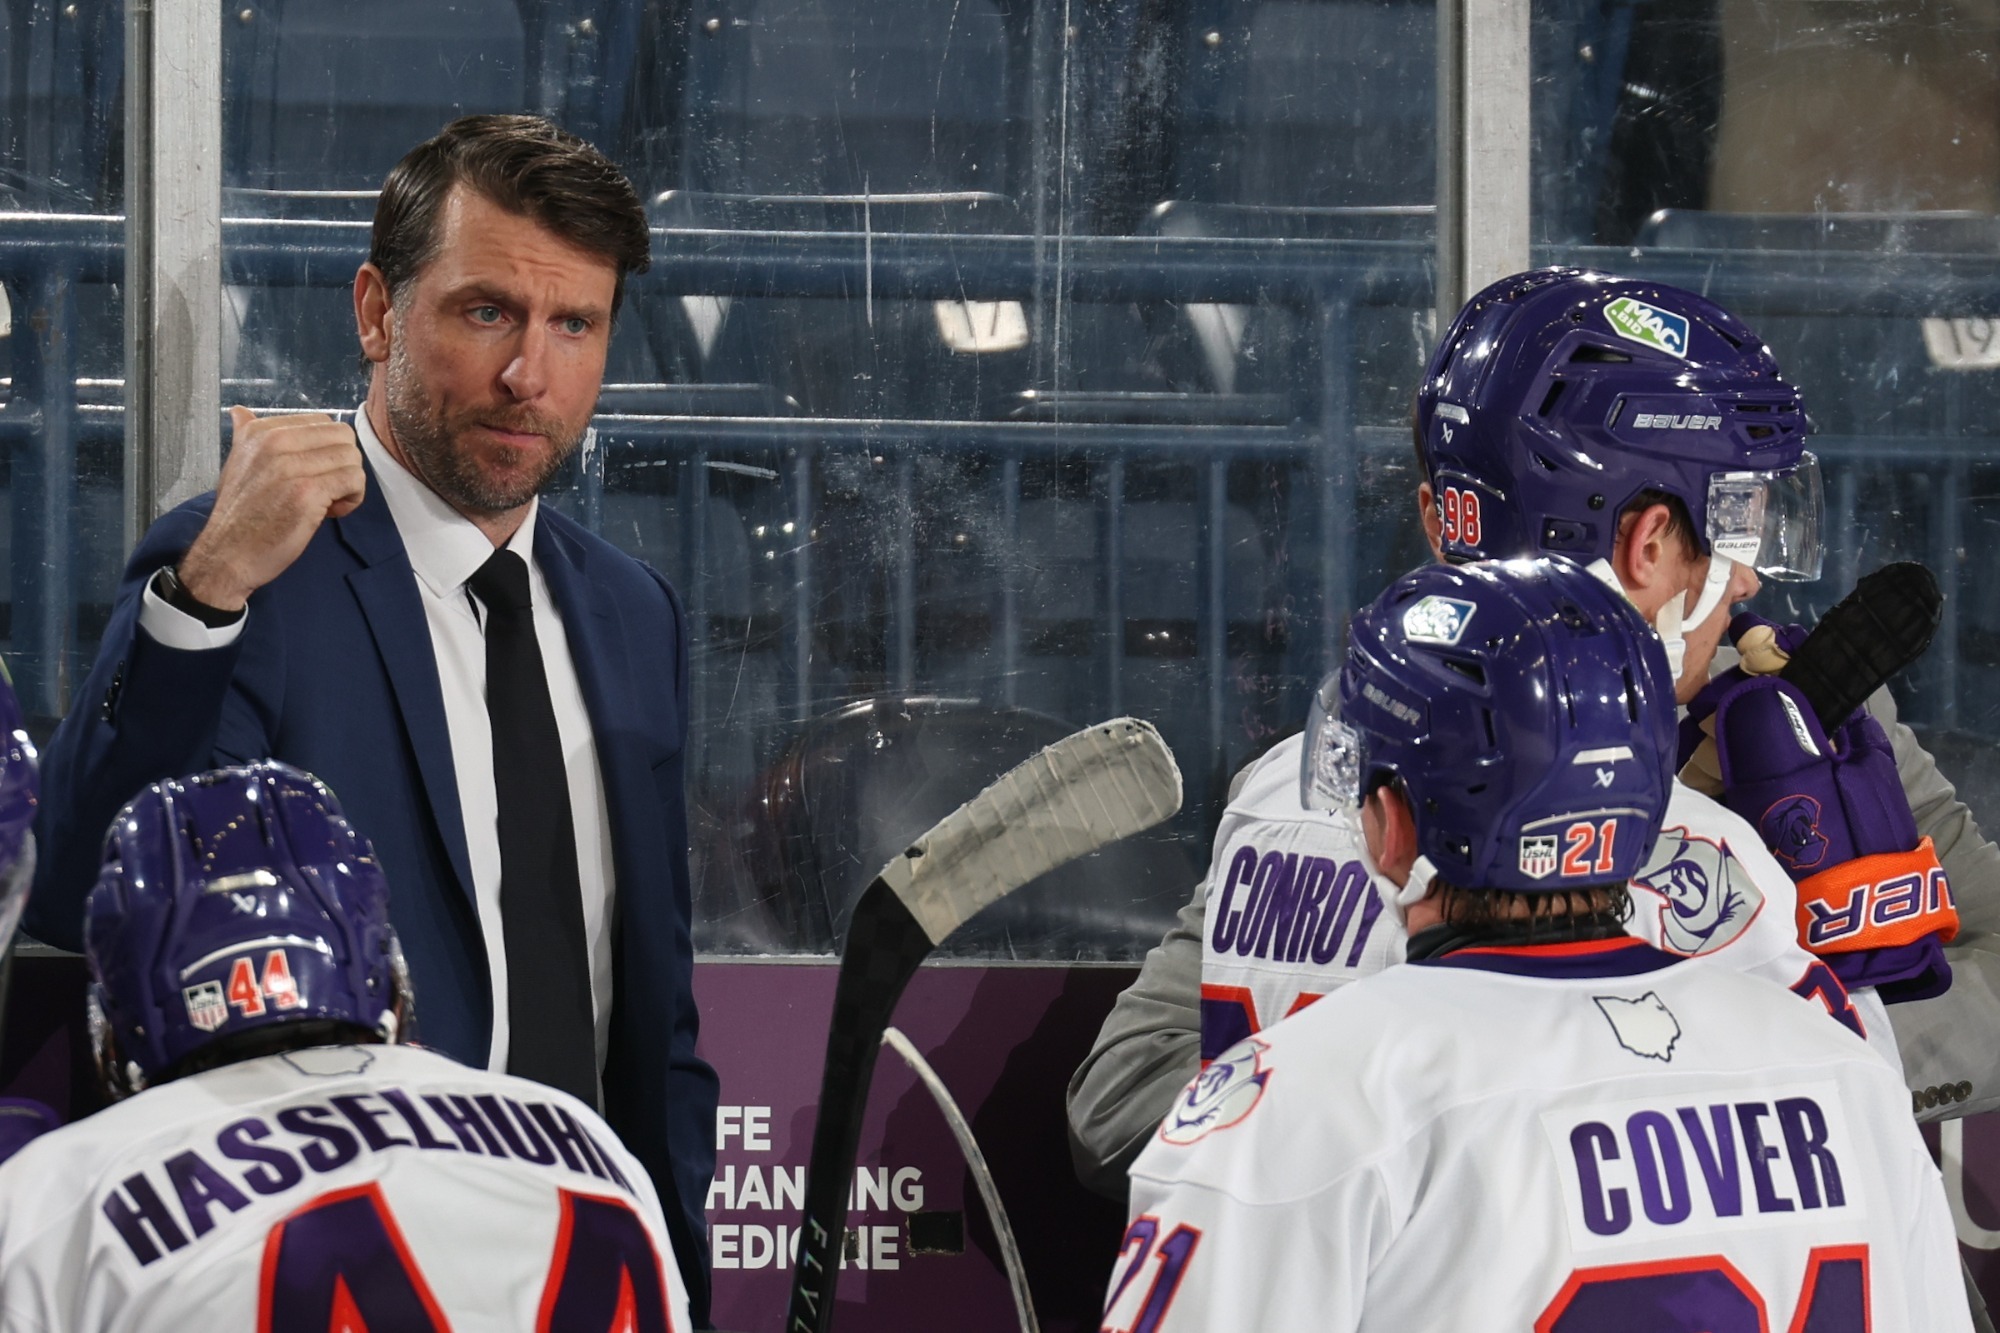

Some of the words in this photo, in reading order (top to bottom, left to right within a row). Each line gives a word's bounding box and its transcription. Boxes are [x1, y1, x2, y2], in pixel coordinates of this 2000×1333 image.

[1623, 300, 1681, 352] MAC
[1632, 413, 1723, 431] BAUER
[1444, 486, 1482, 547] 98
[1715, 540, 1758, 549] BAUER
[1523, 847, 1553, 859] USHL
[1560, 818, 1618, 877] 21
[1211, 845, 1385, 968] CONROY
[1804, 866, 1956, 948] UER
[226, 948, 300, 1019] 44
[716, 1105, 772, 1151] FE
[704, 1165, 924, 1212] HANNG
[1569, 1096, 1847, 1236] COVER
[707, 1224, 900, 1271] EDINE
